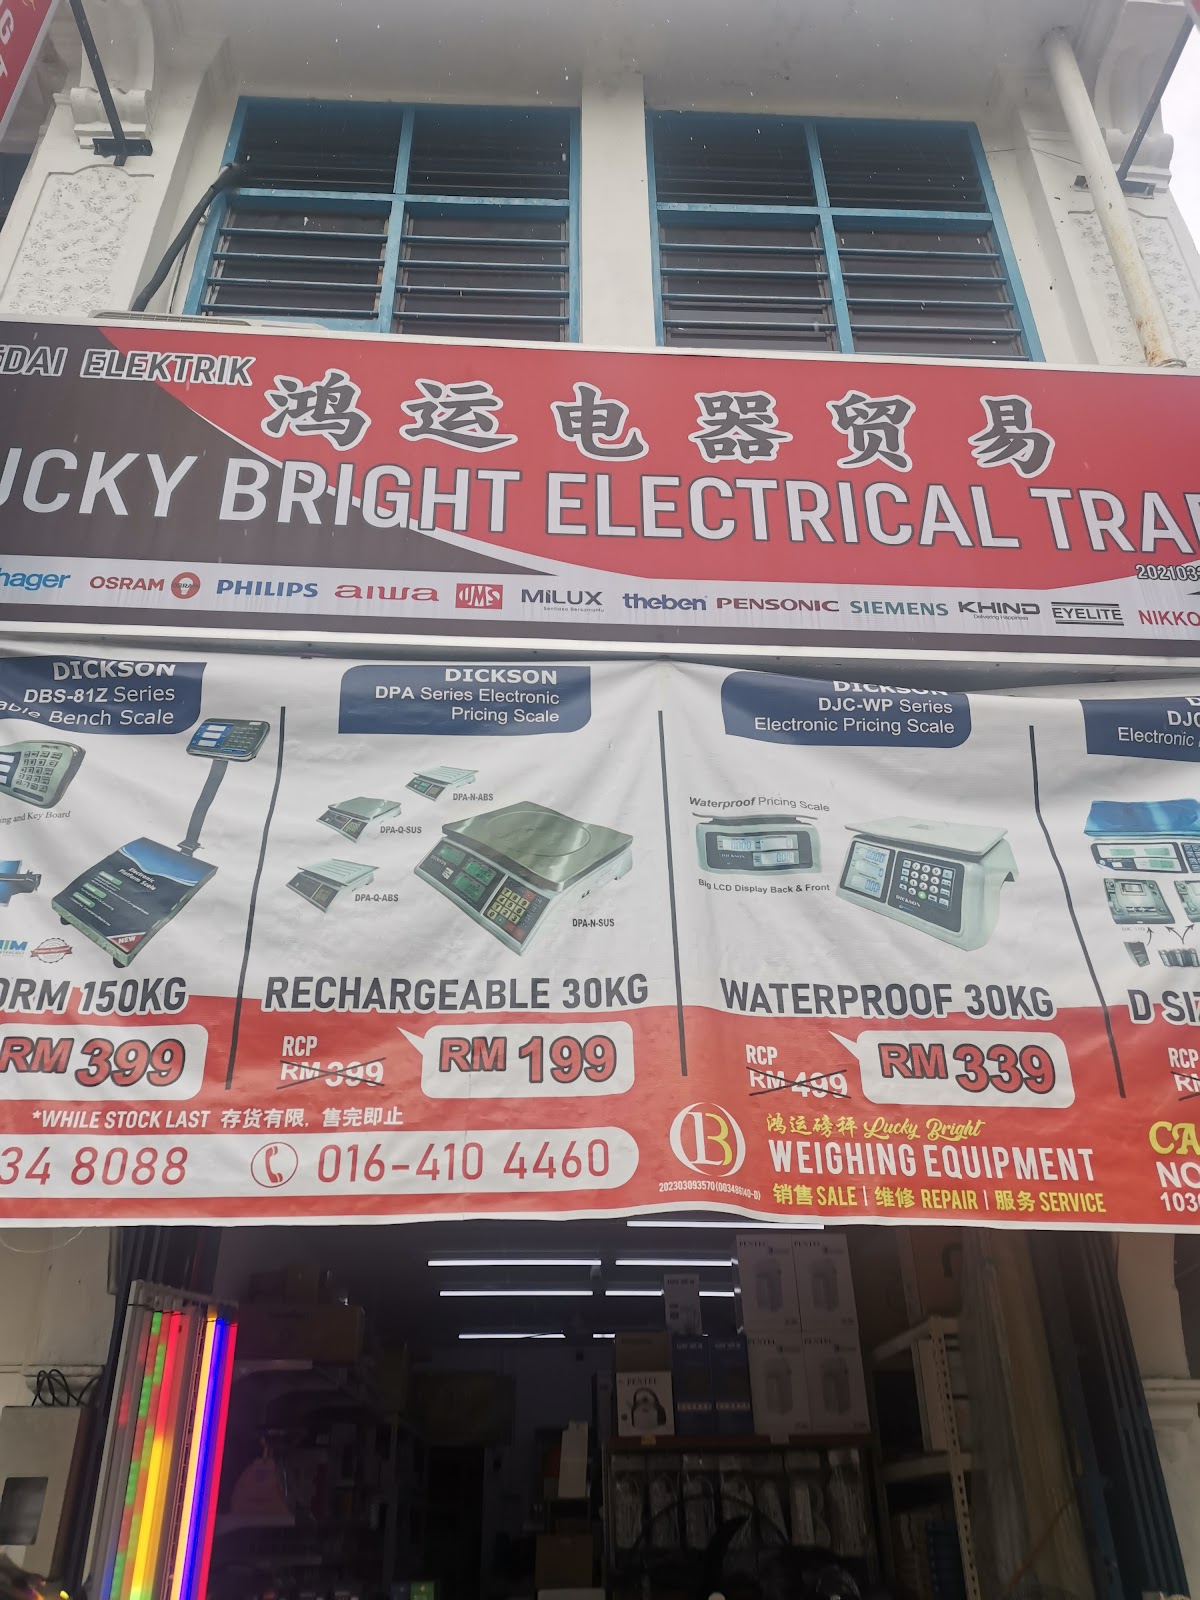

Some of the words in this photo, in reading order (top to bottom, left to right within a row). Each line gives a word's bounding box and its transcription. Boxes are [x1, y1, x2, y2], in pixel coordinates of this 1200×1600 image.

[80, 349, 256, 386] ELEKTRIK
[260, 368, 1055, 478] 鸿运电器贸易
[218, 457, 522, 534] BRIGHT
[546, 471, 1021, 550] ELECTRICAL
[0, 568, 71, 591] hager
[90, 576, 165, 592] OSRAM
[216, 579, 319, 598] PHILIPS
[334, 584, 439, 602] aiwa
[622, 593, 707, 611] theben
[716, 597, 840, 612] PENSONIC
[850, 600, 949, 616] SIEMENS
[958, 601, 1041, 615] KHIND
[1053, 607, 1123, 621] EYELITE
[53, 660, 176, 681] DICKSON
[444, 668, 557, 685] DICKSON
[23, 687, 108, 704] DBS-81Z
[114, 686, 176, 702] Series
[375, 686, 415, 700] DPA
[420, 687, 473, 702] Series
[479, 689, 561, 705] Electronic
[832, 680, 949, 696] DICK
[451, 706, 508, 724] Pricing
[513, 709, 560, 724] Scale
[818, 698, 893, 713] DJC-WP
[899, 699, 953, 715] Series
[48, 710, 111, 726] Bench
[120, 709, 174, 725] Scale
[754, 716, 839, 732] Electronic
[843, 717, 902, 736] Pricing
[906, 718, 955, 734] Scale
[1117, 726, 1195, 747] Electronic
[452, 793, 494, 802] DPA-N-ABS
[689, 796, 755, 810] Waterproof
[758, 796, 797, 809] Pricing
[799, 801, 830, 812] Scale
[13, 813, 26, 823] and
[28, 811, 44, 821] Key
[45, 811, 71, 819] Board
[380, 825, 422, 835] DPA-Q-SUS
[698, 878, 712, 890] Big
[713, 883, 732, 892] LCD
[735, 884, 768, 894] Display
[770, 885, 793, 893] Back
[795, 884, 803, 893] &
[805, 883, 831, 891] Front
[354, 893, 399, 903] DPA-Q-ABS
[572, 918, 615, 928] DPA-N-SUS
[118, 935, 137, 944] NEW
[81, 976, 186, 1014] 150KG
[265, 975, 550, 1011] RECHARGEABLE
[562, 973, 649, 1009] 30KG
[720, 977, 952, 1016] WATERPROOF
[964, 983, 1054, 1018] 30KG
[1127, 989, 1152, 1021] D
[282, 1035, 318, 1057] RCP
[745, 1044, 778, 1066] RCP
[0, 1036, 75, 1074] RM
[75, 1038, 187, 1088] 399
[440, 1036, 506, 1072] RM
[517, 1035, 618, 1084] 199
[1167, 1047, 1200, 1069] RCP
[280, 1060, 321, 1081] RM
[324, 1061, 385, 1088] 399
[878, 1042, 949, 1080] RM
[953, 1043, 1056, 1095] 339
[748, 1068, 786, 1089] RM
[791, 1070, 848, 1099] 499
[104, 1110, 163, 1129] STOCK
[165, 1110, 211, 1128] LAST
[321, 1106, 404, 1128] 售完即止
[863, 1116, 921, 1140] Lucky
[925, 1117, 986, 1142] Bright
[0, 1146, 51, 1186] 34
[71, 1146, 188, 1186] 8088
[318, 1141, 484, 1183] 016-410
[503, 1139, 610, 1180] 4460
[768, 1139, 916, 1177] WEIGHING
[925, 1144, 1095, 1182] EQUIPMENT
[773, 1183, 814, 1207] 销售
[816, 1186, 857, 1206] SALE
[874, 1187, 915, 1209] 维修
[921, 1189, 979, 1211] REPAIR
[996, 1189, 1035, 1212] 服务
[1040, 1191, 1107, 1214] SERVICE
[1160, 1191, 1200, 1212] 103
